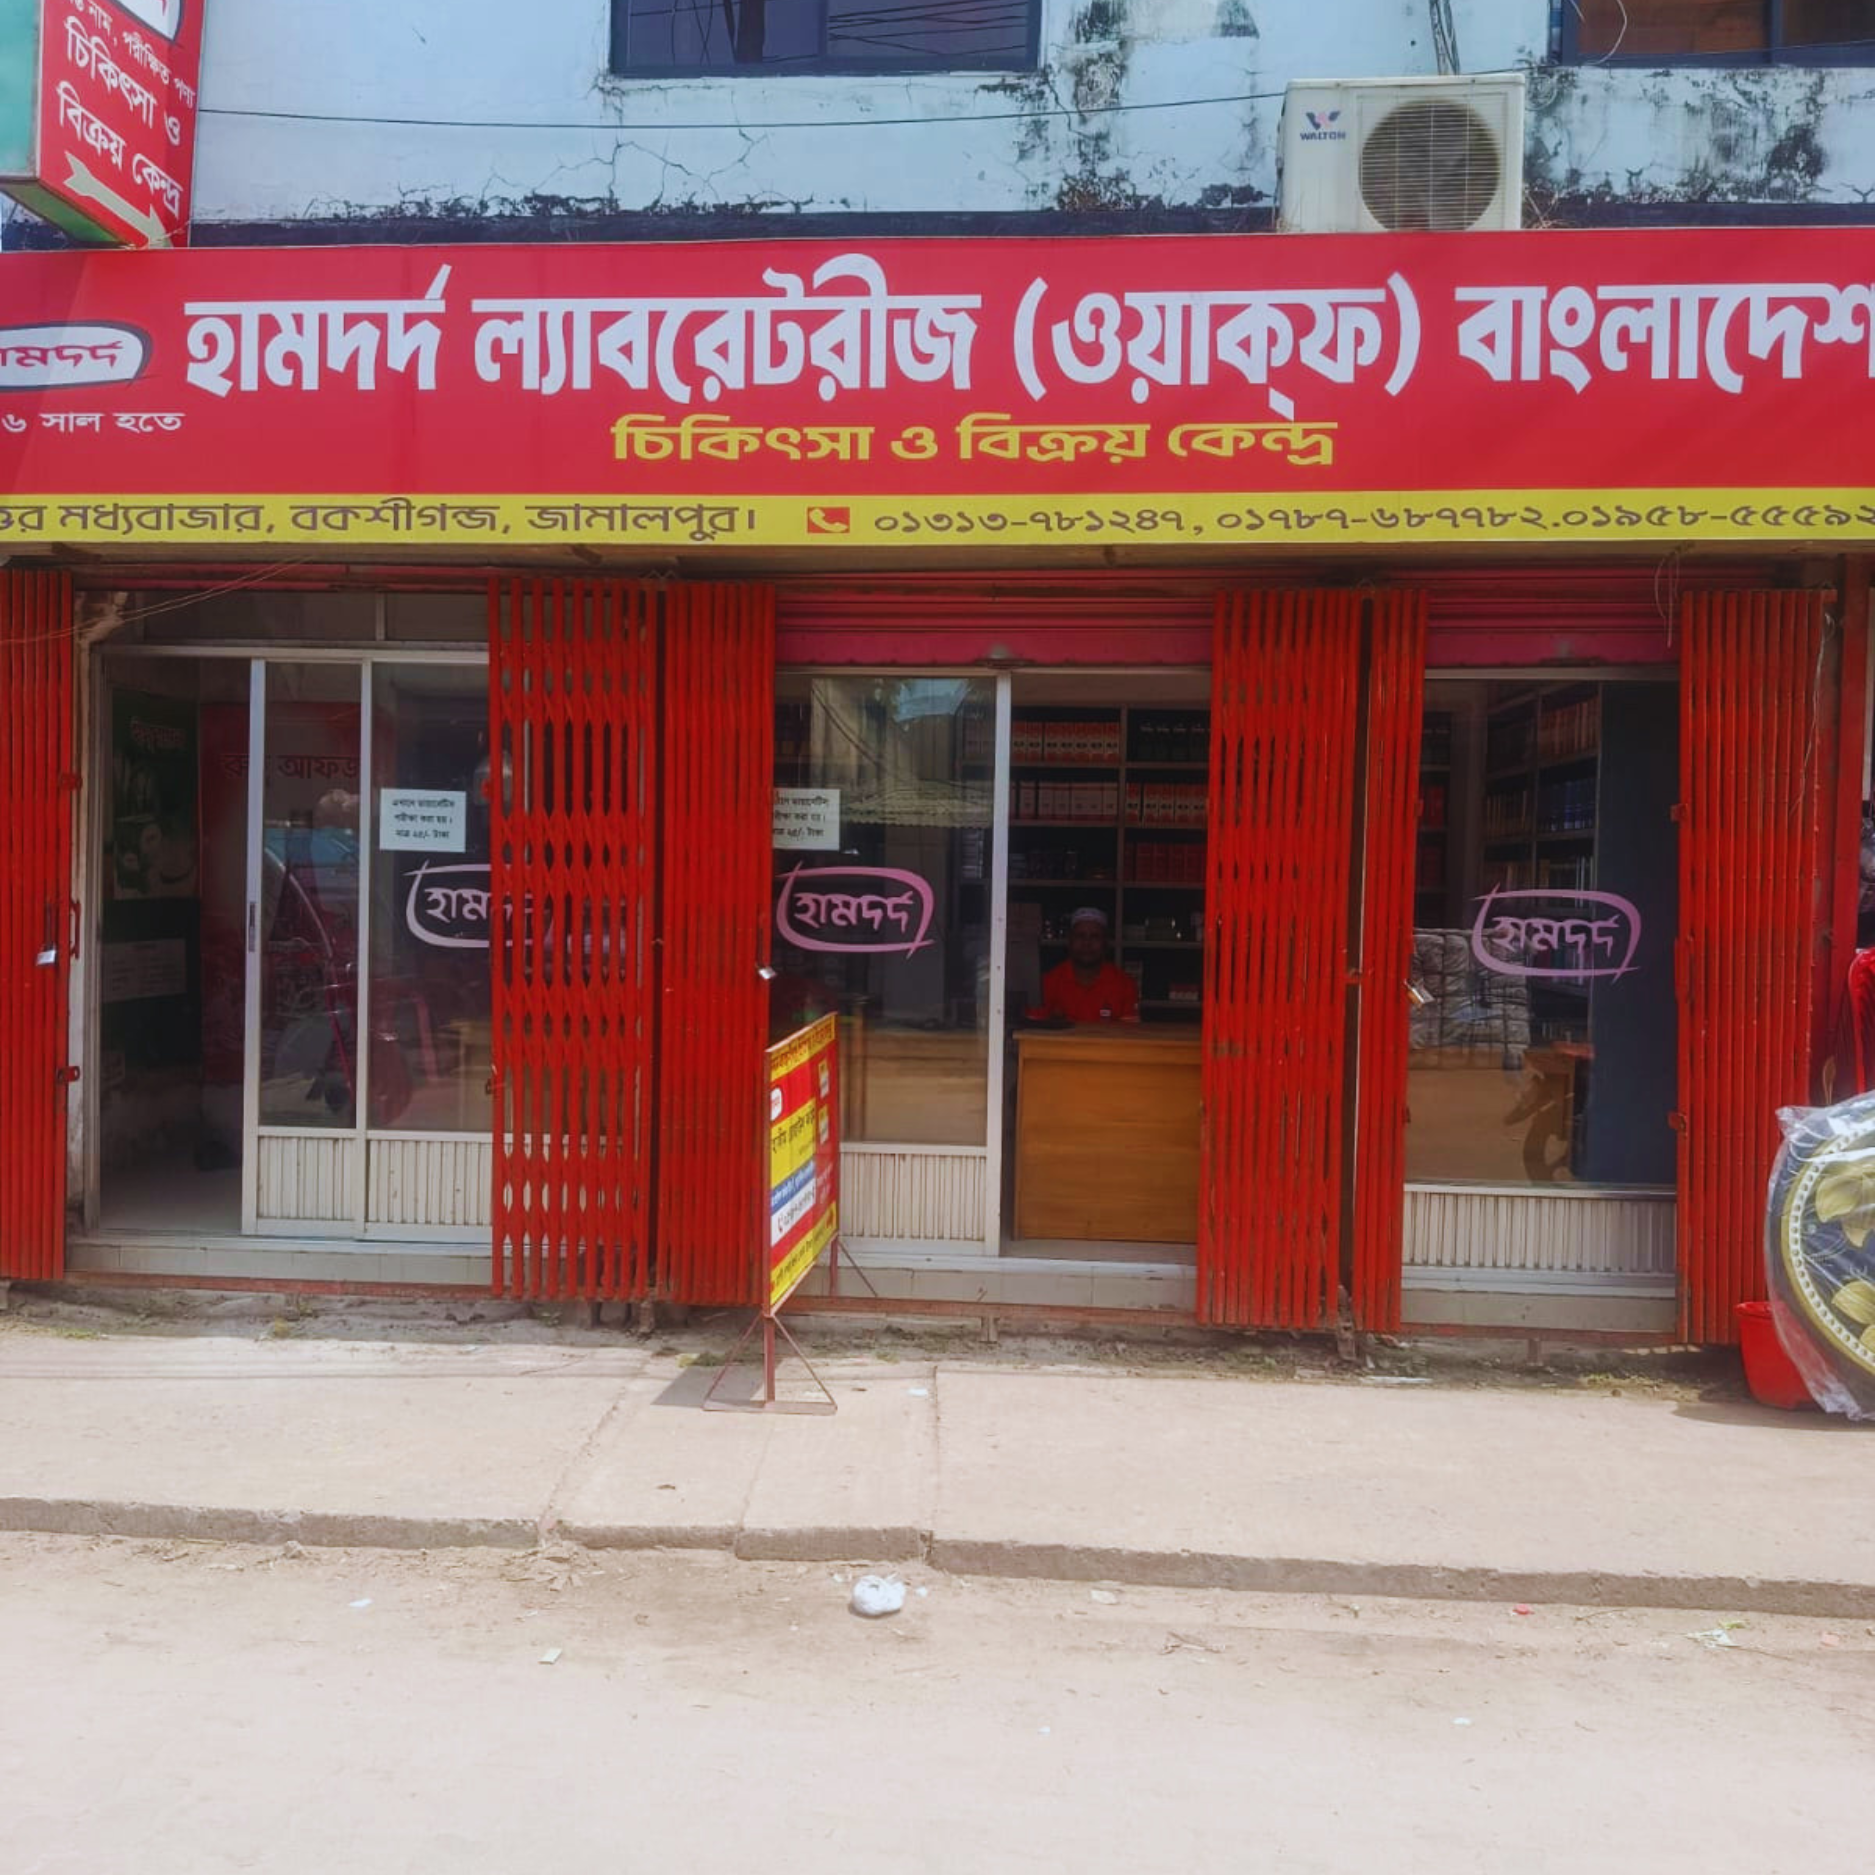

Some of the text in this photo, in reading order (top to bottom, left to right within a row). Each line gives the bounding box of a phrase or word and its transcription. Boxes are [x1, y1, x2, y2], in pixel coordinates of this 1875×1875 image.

[64, 16, 181, 146] চিকিৎসা ও
[56, 81, 183, 220] বিক্রয় কেন্দ্র
[1299, 131, 1346, 140] WALTON
[184, 264, 452, 397] হামদর্দ
[471, 253, 982, 403] ল্যাবরেটরীজ
[1455, 282, 1875, 394] বাংলাদেশ
[0, 341, 123, 367] ামদর্দ
[41, 413, 103, 433] সাল
[113, 413, 186, 433] হতে
[611, 412, 1338, 466] চিকিৎসা ও বিক্রয় কেন্দ্র
[57, 503, 275, 535] মধ্যবাজার,
[794, 890, 914, 933] হামদর্দ
[1492, 914, 1620, 957] হামদর্দ
